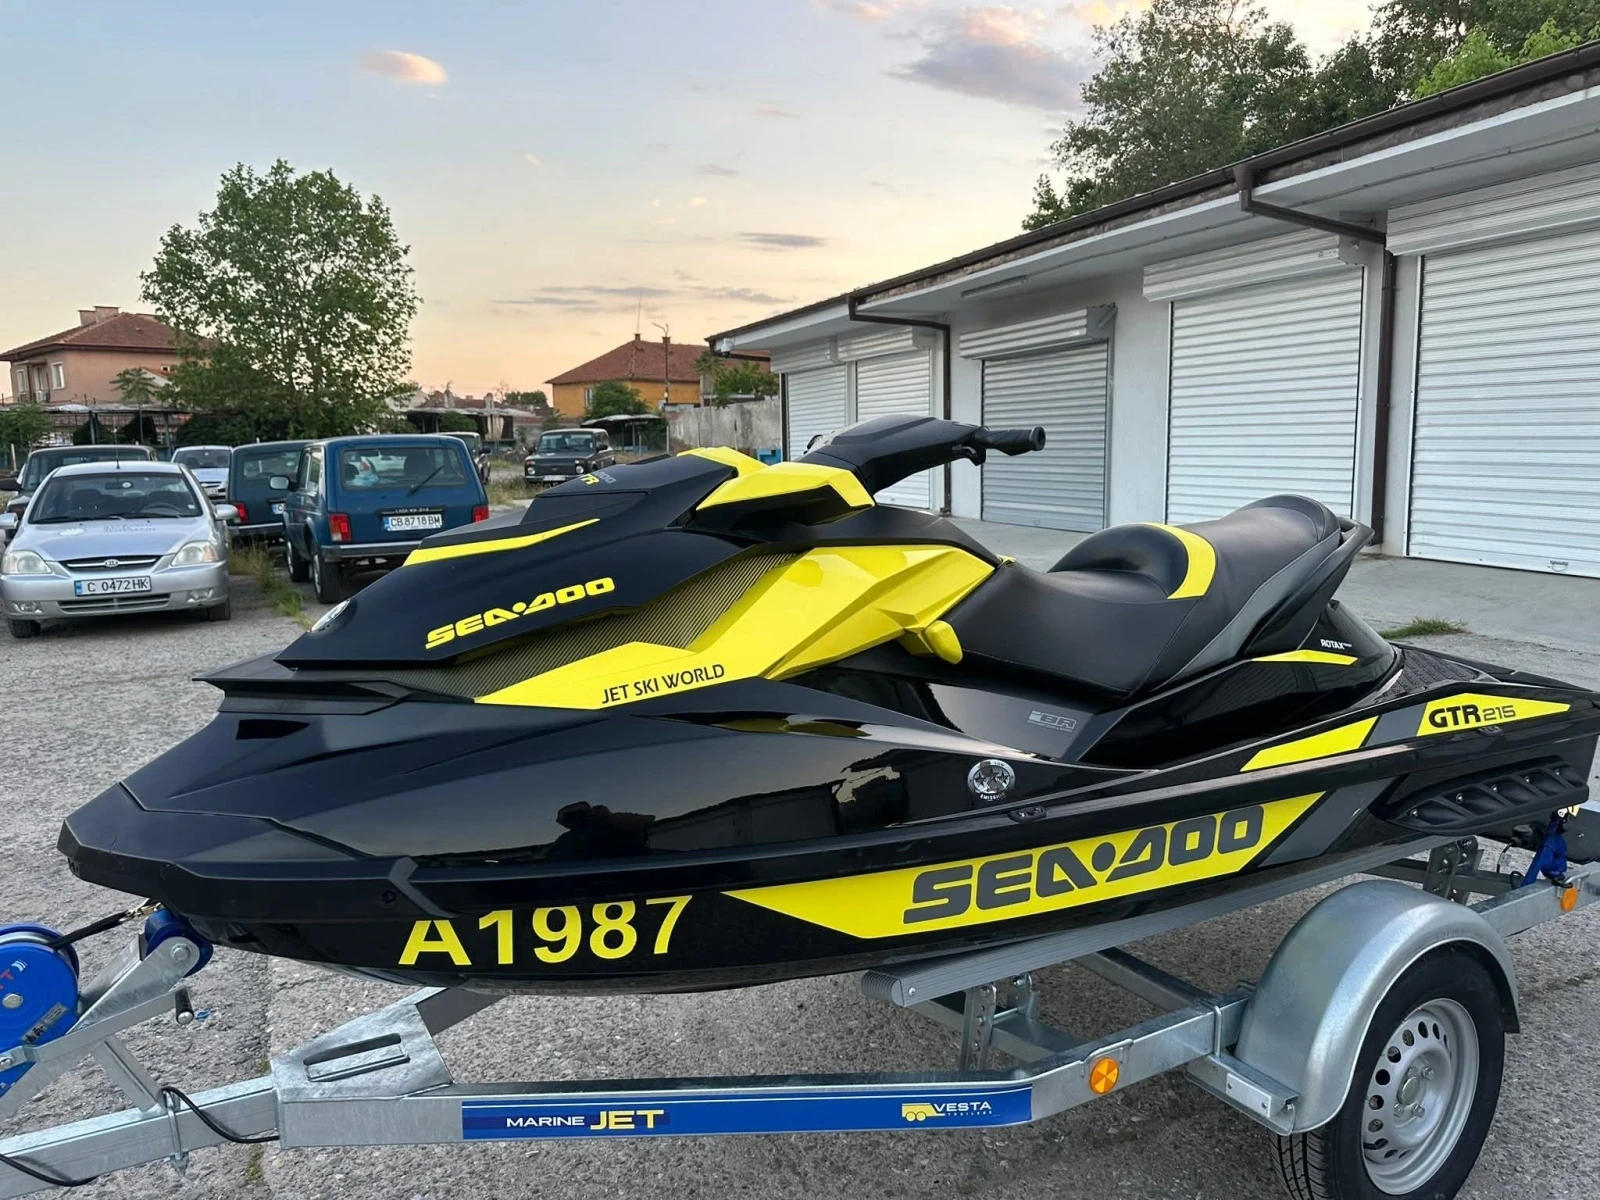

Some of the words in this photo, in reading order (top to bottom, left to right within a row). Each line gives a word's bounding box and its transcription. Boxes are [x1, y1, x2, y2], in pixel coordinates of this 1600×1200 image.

[1320, 639, 1345, 650] ROTAX
[601, 684, 628, 704] JET
[635, 677, 659, 696] SKI
[661, 664, 725, 689] WORLD
[1428, 704, 1481, 728] GTR
[1482, 705, 1516, 721] 215
[933, 1101, 992, 1112] VESTA
[506, 1116, 586, 1128] MARINE
[590, 1109, 665, 1131] JET
